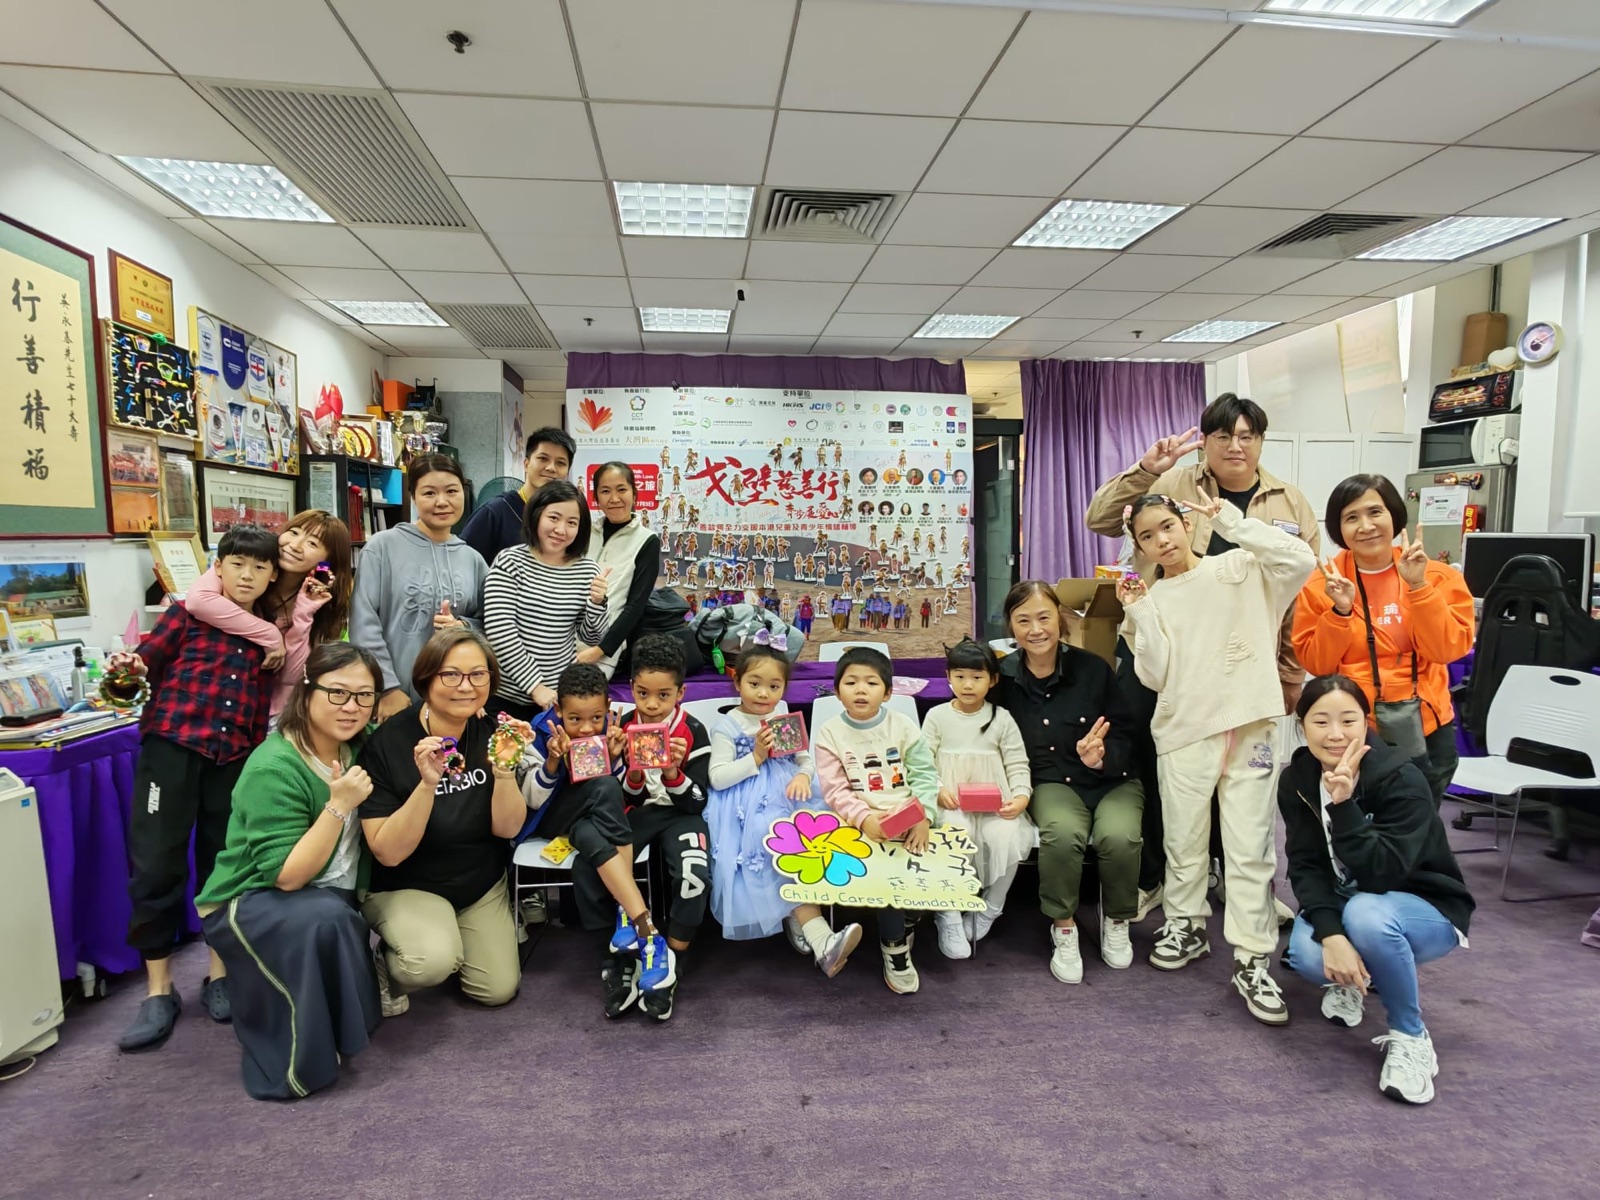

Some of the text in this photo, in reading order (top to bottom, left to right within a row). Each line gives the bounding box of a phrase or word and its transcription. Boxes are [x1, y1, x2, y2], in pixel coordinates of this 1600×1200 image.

[12, 278, 50, 480] 行善積福
[809, 403, 825, 411] JCI
[678, 832, 708, 900] FILA
[782, 888, 986, 909] Child Cares Foundation
